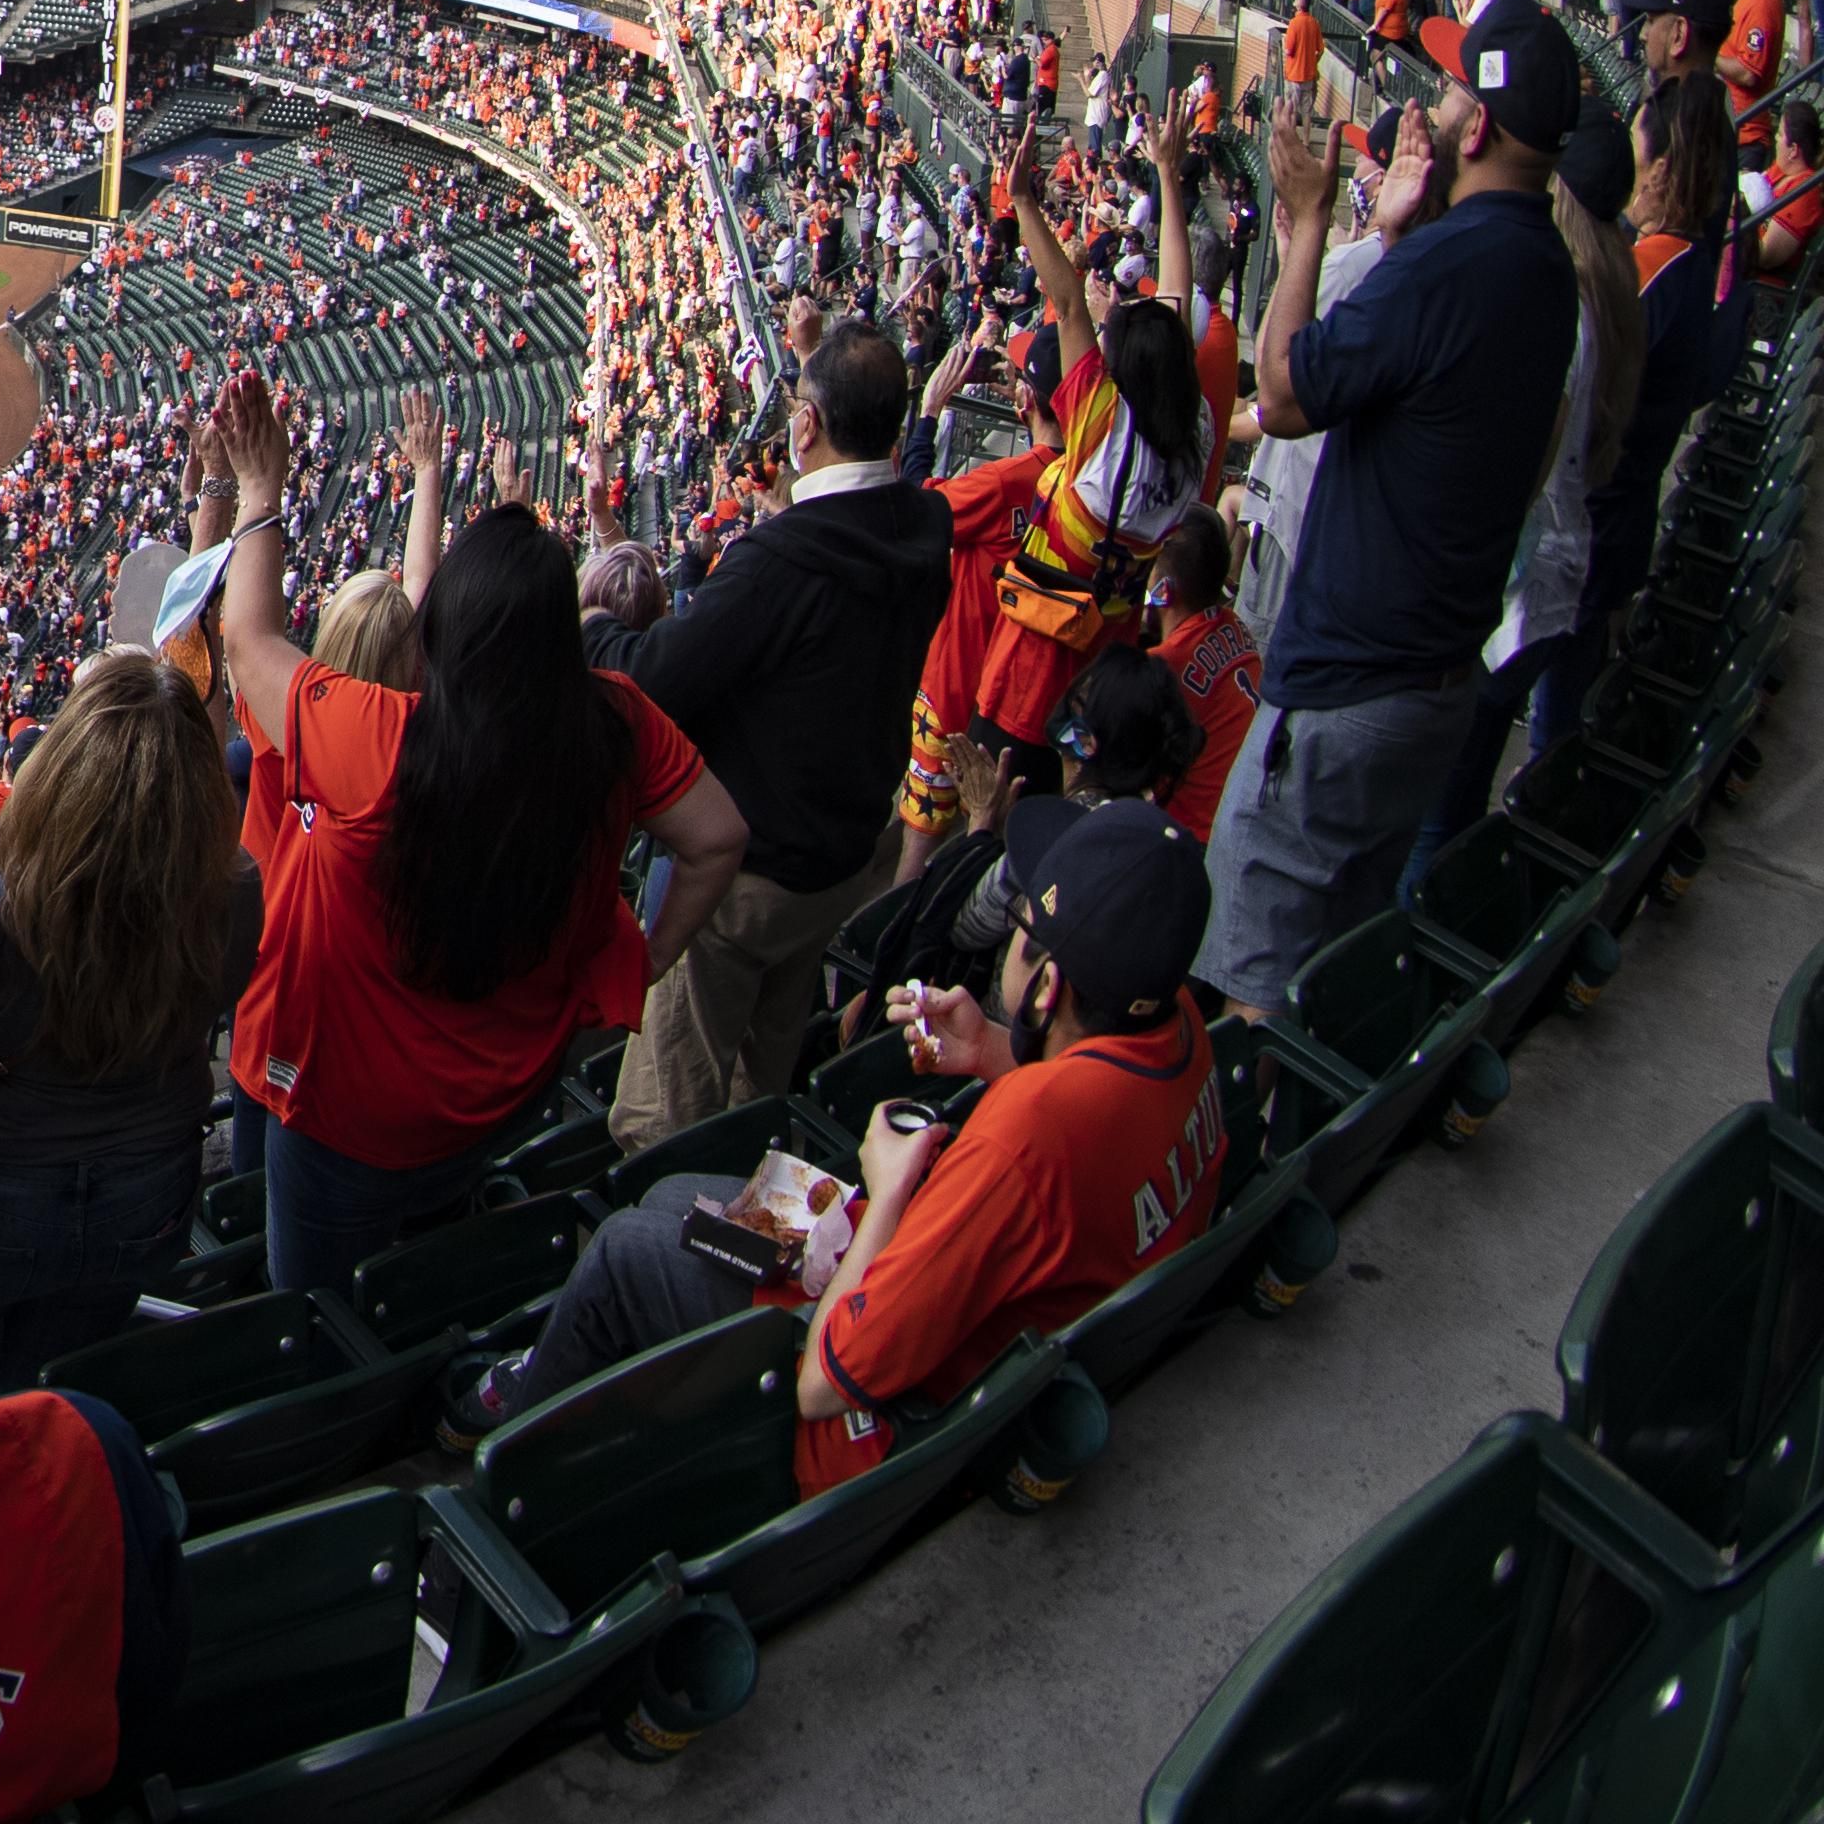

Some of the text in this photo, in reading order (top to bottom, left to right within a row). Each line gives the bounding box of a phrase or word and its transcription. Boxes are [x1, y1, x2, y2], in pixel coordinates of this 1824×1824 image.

[8, 220, 90, 244] POWERADE
[1182, 619, 1259, 697] CORRE
[1133, 1064, 1224, 1256] ALTU
[690, 1237, 763, 1276] BUFFALO WILD WINGS
